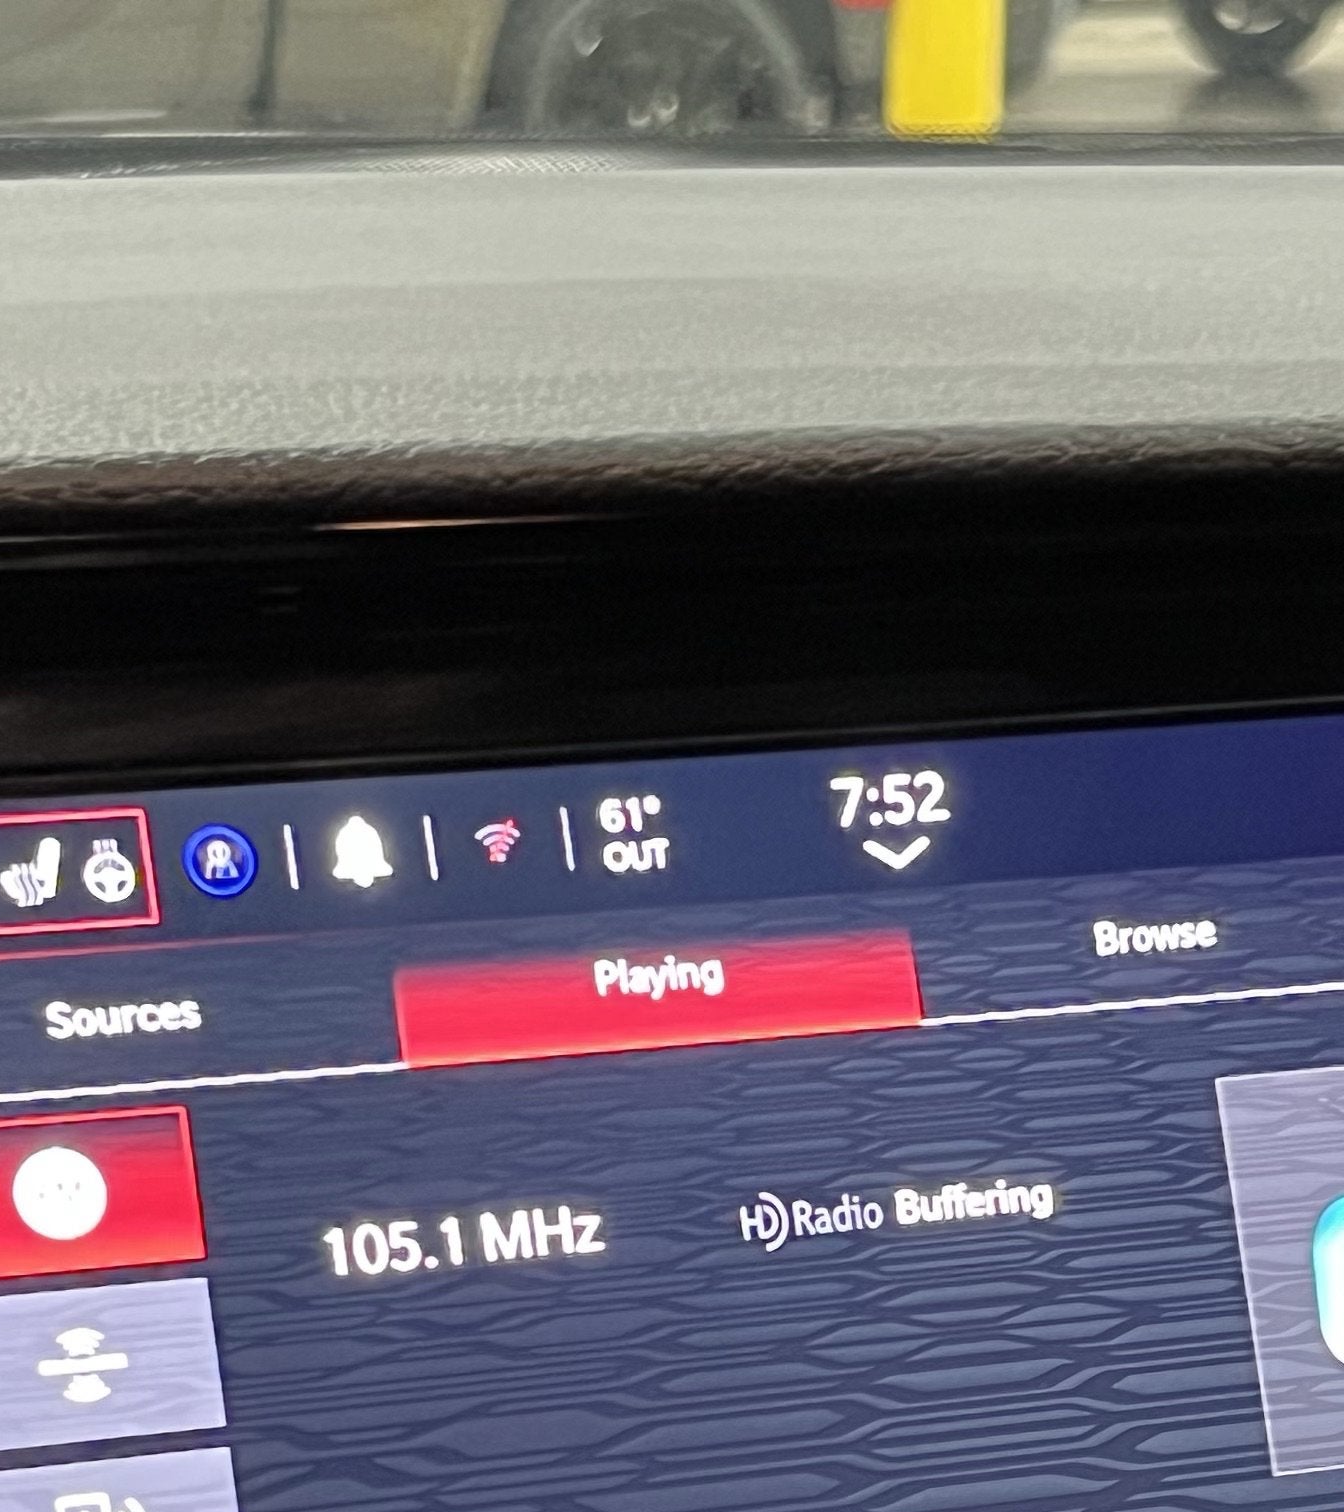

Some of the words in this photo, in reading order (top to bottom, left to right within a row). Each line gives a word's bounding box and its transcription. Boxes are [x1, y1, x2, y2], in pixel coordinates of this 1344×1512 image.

[830, 770, 951, 828] 7:52
[601, 836, 670, 874] OUT
[1092, 913, 1219, 957] Browse
[593, 955, 725, 1000] Playing
[43, 999, 202, 1040] Sources
[791, 1194, 885, 1238] Radio
[894, 1178, 1053, 1228] Buffering
[321, 1218, 463, 1278] 105.1
[480, 1206, 607, 1263] MHz
